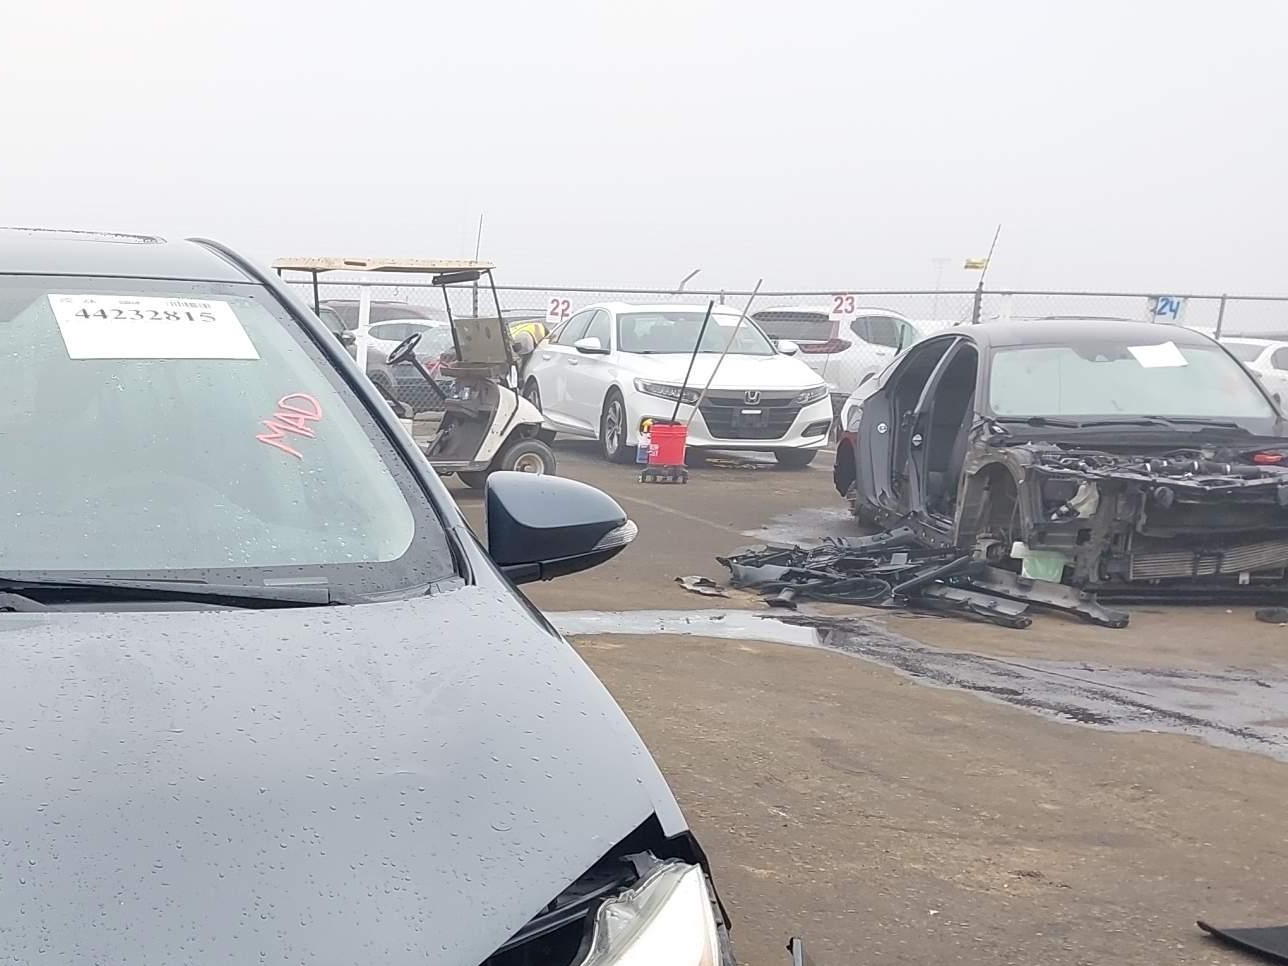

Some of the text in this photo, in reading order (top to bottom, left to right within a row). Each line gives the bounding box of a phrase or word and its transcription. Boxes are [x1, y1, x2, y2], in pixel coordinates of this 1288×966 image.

[550, 298, 570, 317] 22
[832, 296, 855, 314] 23
[1157, 297, 1180, 320] 24
[74, 308, 216, 323] 44232815
[255, 393, 322, 460] MAD
